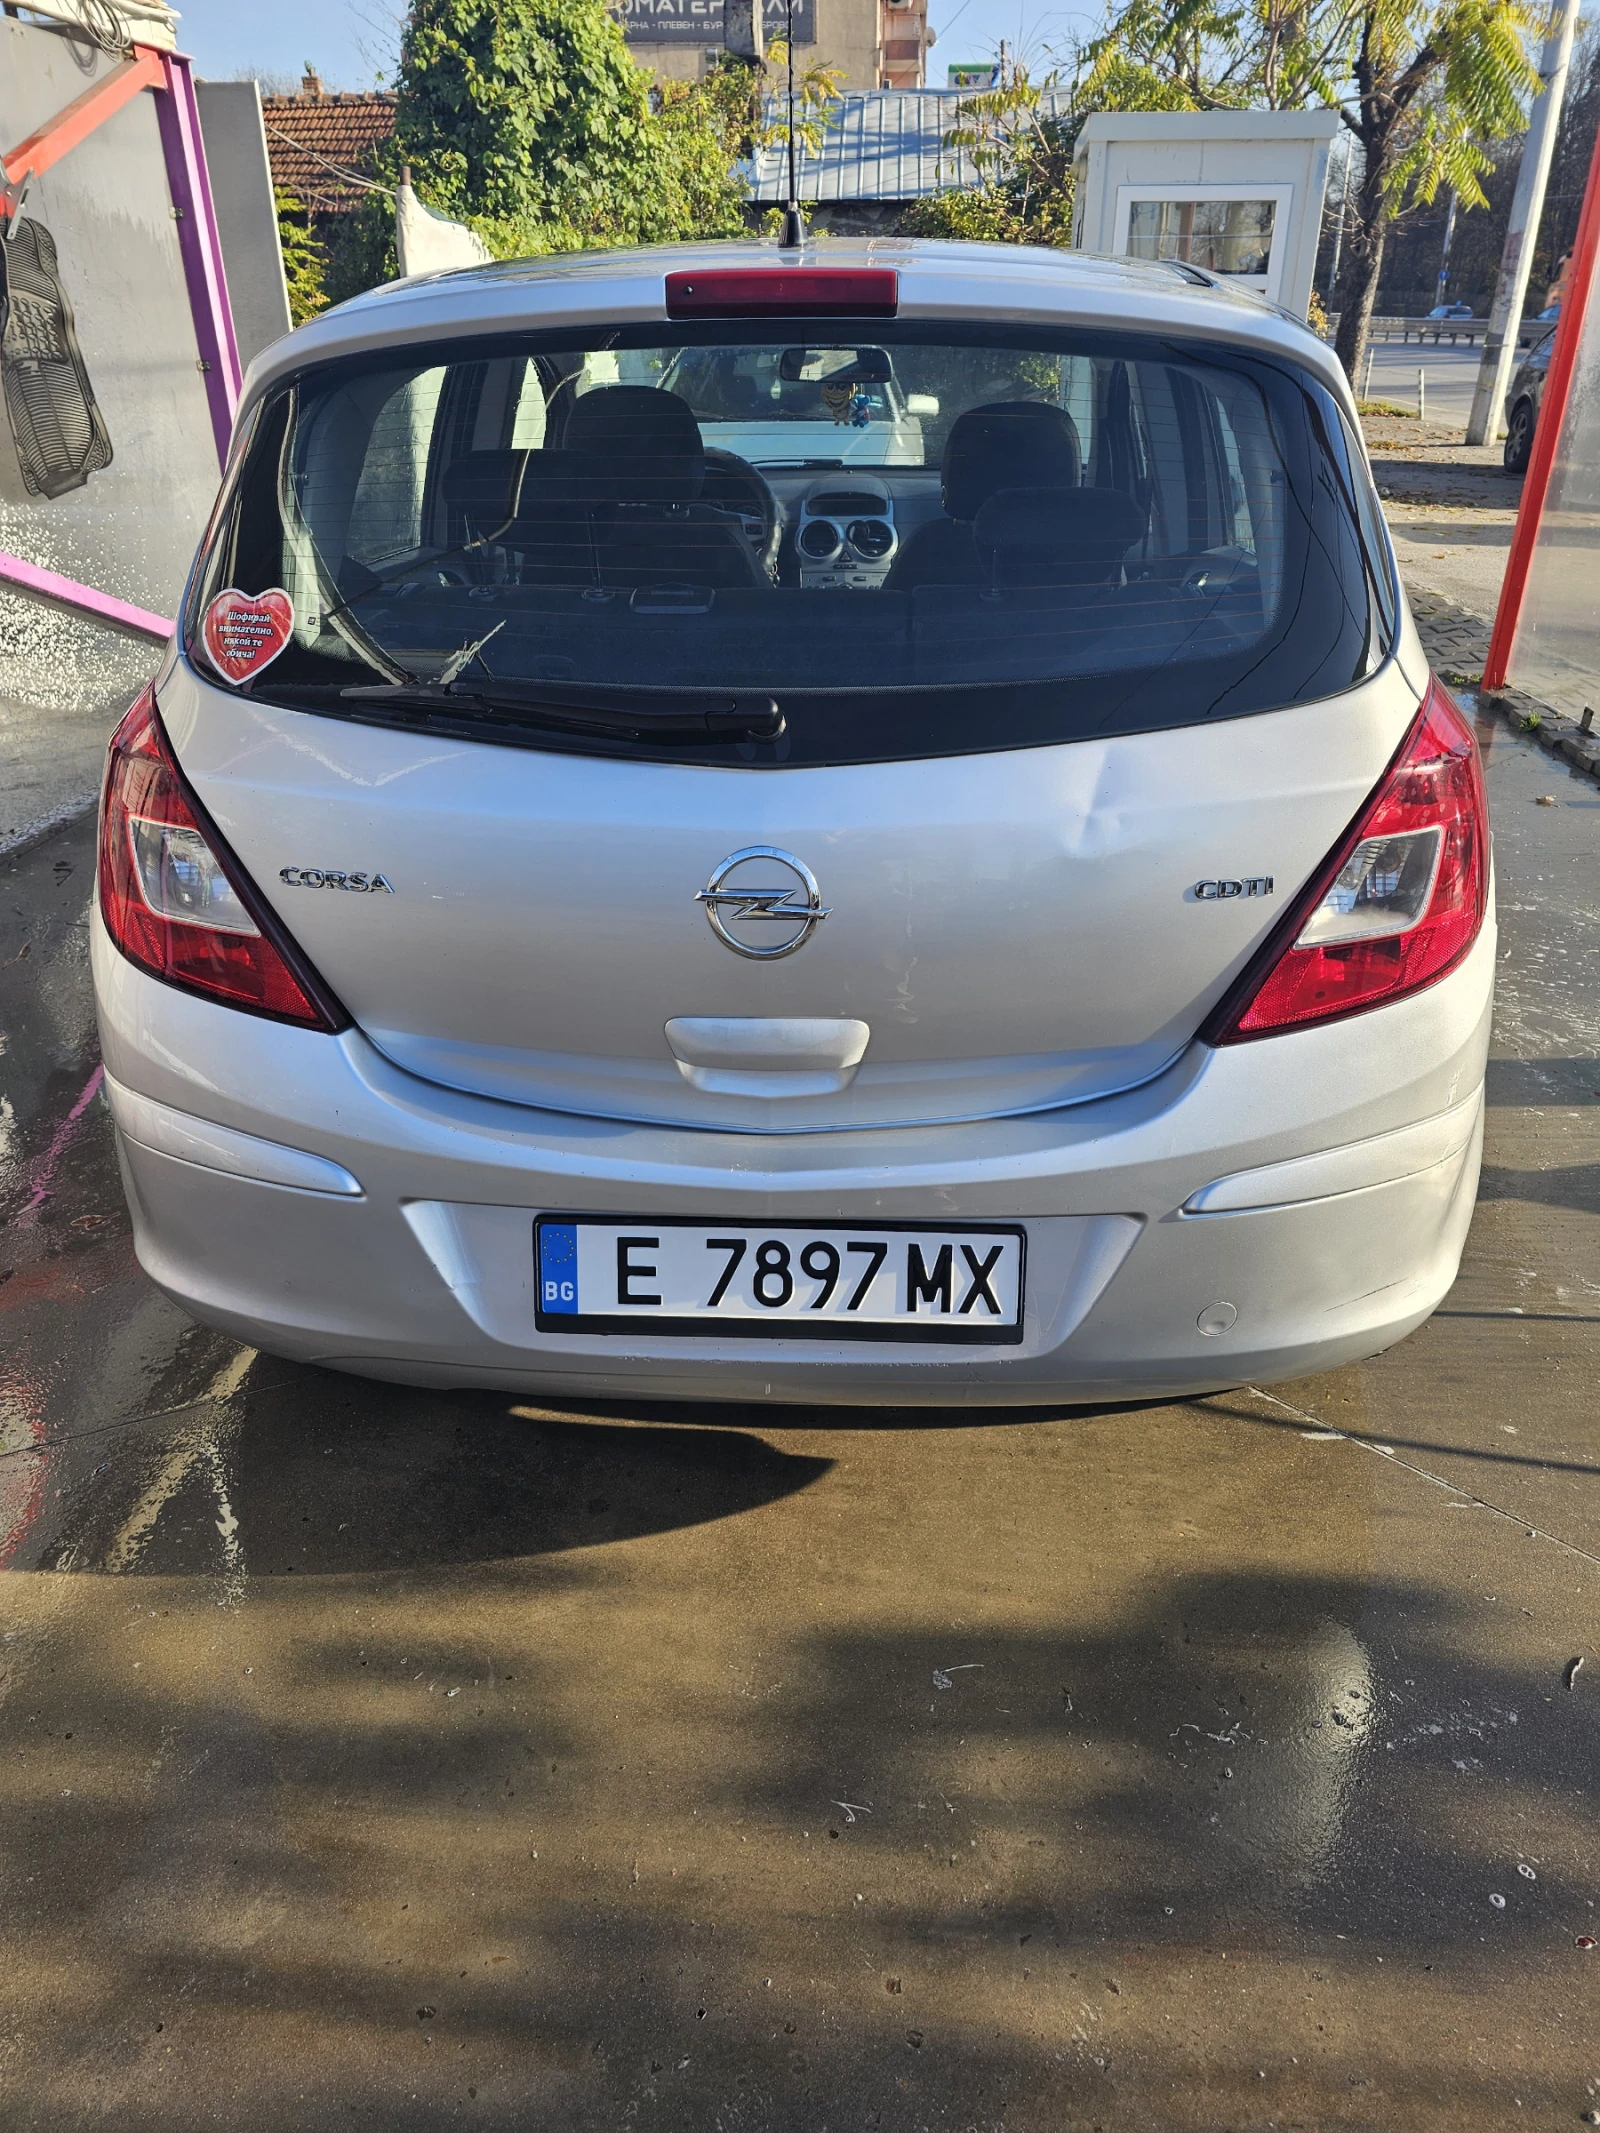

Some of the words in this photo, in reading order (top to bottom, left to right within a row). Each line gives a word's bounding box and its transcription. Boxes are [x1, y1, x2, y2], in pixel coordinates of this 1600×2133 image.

[623, 21, 649, 30] АРНА
[657, 21, 695, 30] ПЛЕВЕН
[703, 21, 724, 30] БУР
[227, 611, 270, 623] Шофирай
[218, 625, 274, 636] внимателно,
[223, 637, 251, 646] някой
[226, 648, 255, 658] обича!
[278, 866, 395, 893] CORSA
[1194, 876, 1274, 900] CDTI
[616, 1236, 663, 1306] E
[705, 1238, 889, 1311] 7897
[906, 1243, 1005, 1315] MX
[544, 1281, 575, 1302] BG
